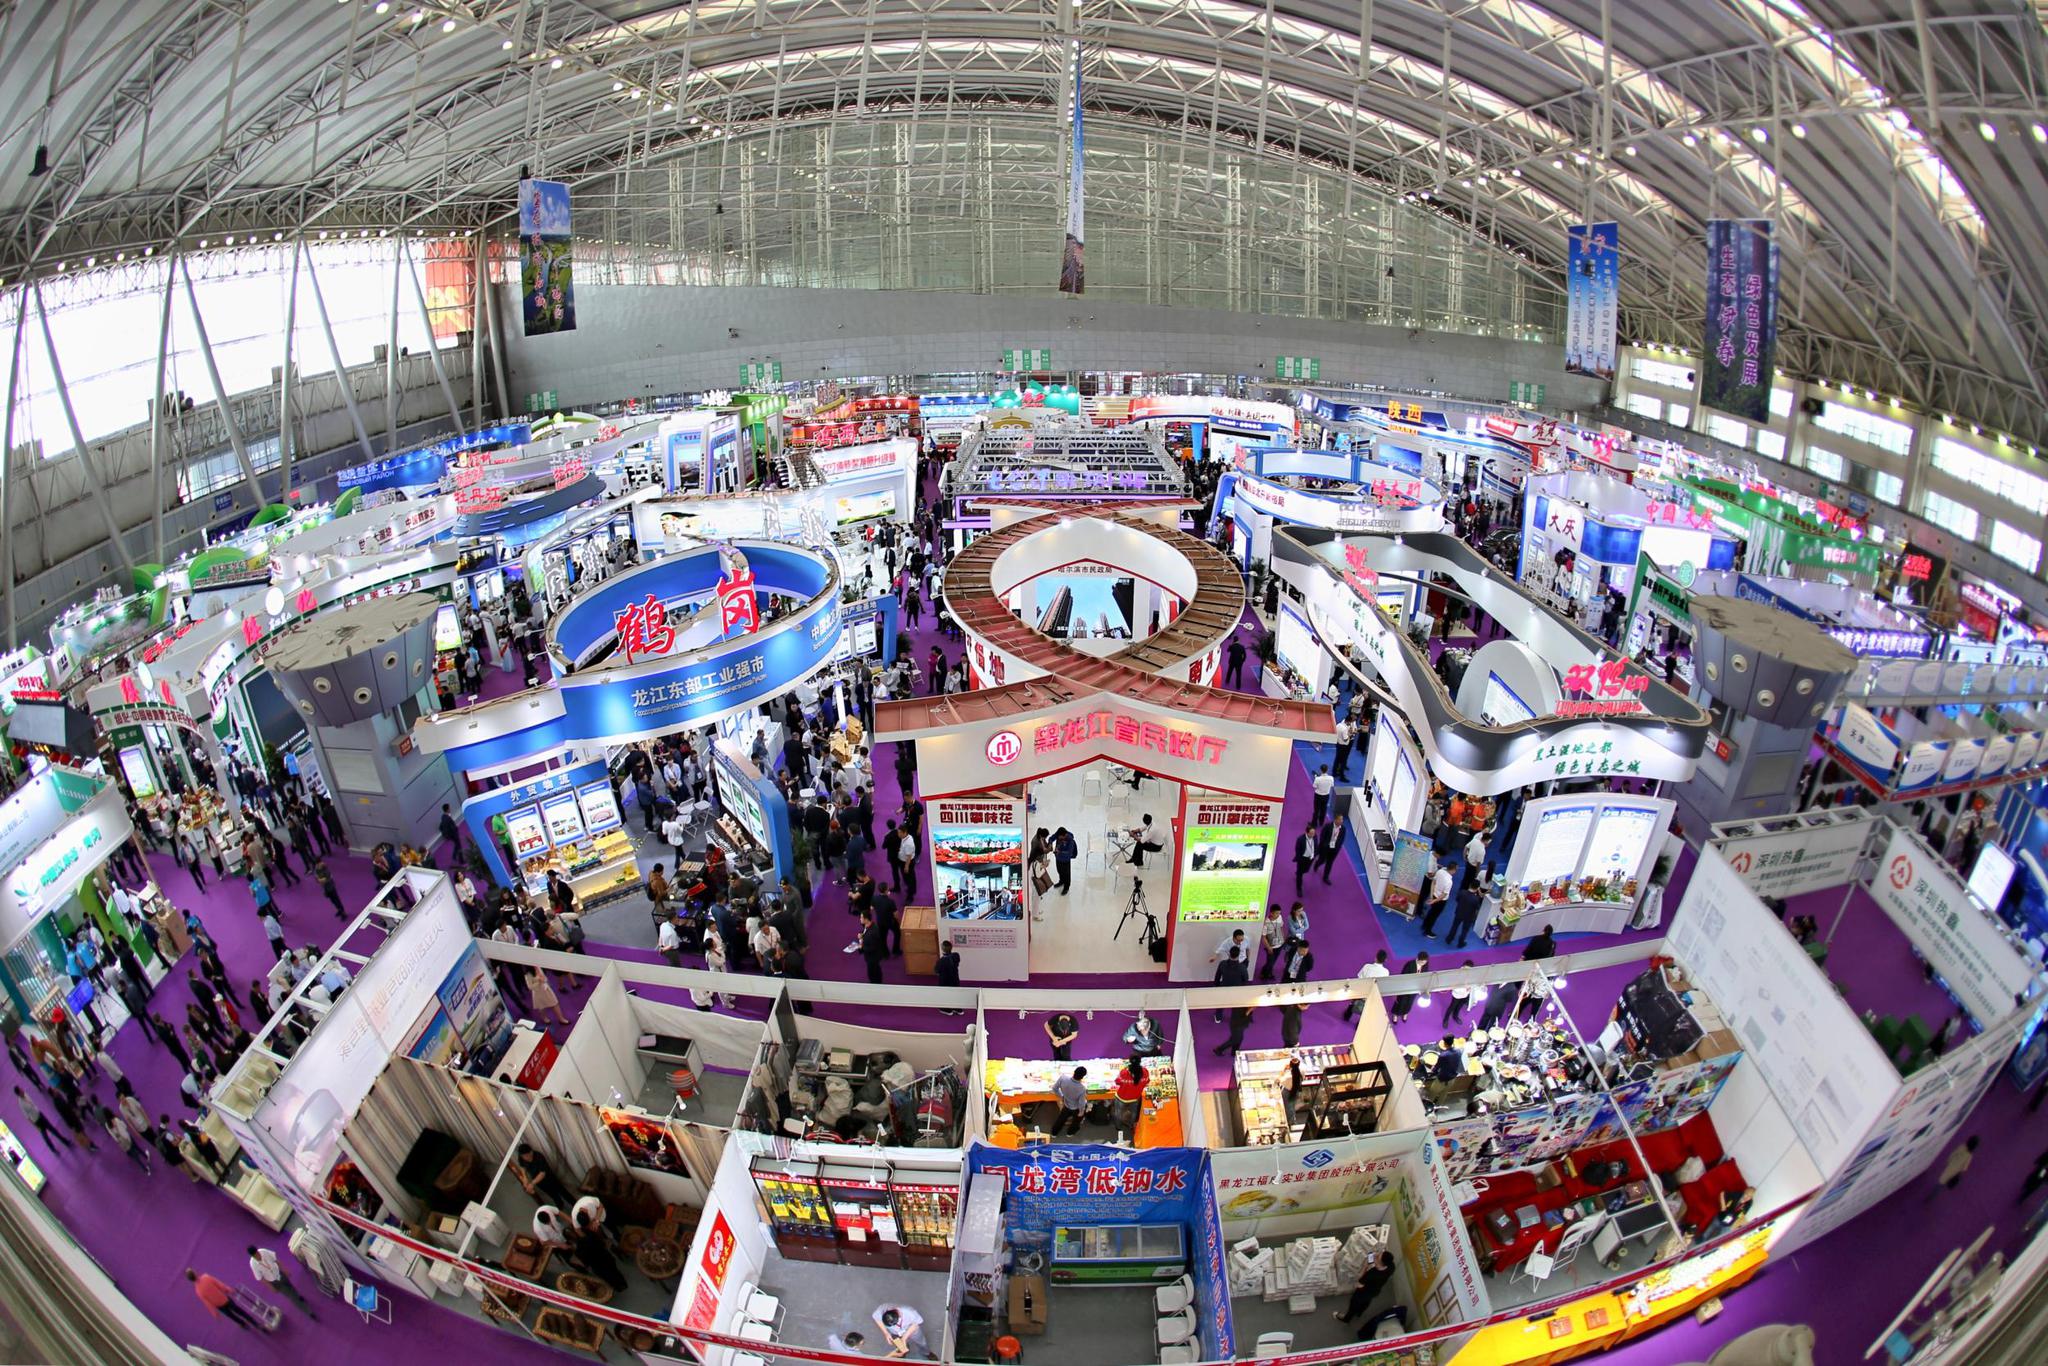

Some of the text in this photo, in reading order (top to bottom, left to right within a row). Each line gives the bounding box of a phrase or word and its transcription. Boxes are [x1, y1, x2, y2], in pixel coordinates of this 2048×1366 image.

[1716, 245, 1738, 366] 生态伊春
[1741, 274, 1762, 386] 绿色发展
[1388, 400, 1424, 423] 陕西
[454, 486, 501, 503] 牡丹江
[1646, 500, 1677, 524] 中国
[1549, 513, 1577, 542] 大庆
[1057, 565, 1113, 574] 哈尔滨市民政局
[615, 568, 759, 663] 鹤岗
[631, 655, 764, 707] 龙江东部工业强市
[1564, 656, 1649, 696] 双鸭山
[1034, 711, 1229, 766] 黑龙江省民政厅
[1554, 759, 1641, 775] 绿色生态之城
[939, 811, 1013, 824] 四川攀枝花
[1197, 812, 1269, 825] 四川攀枝花
